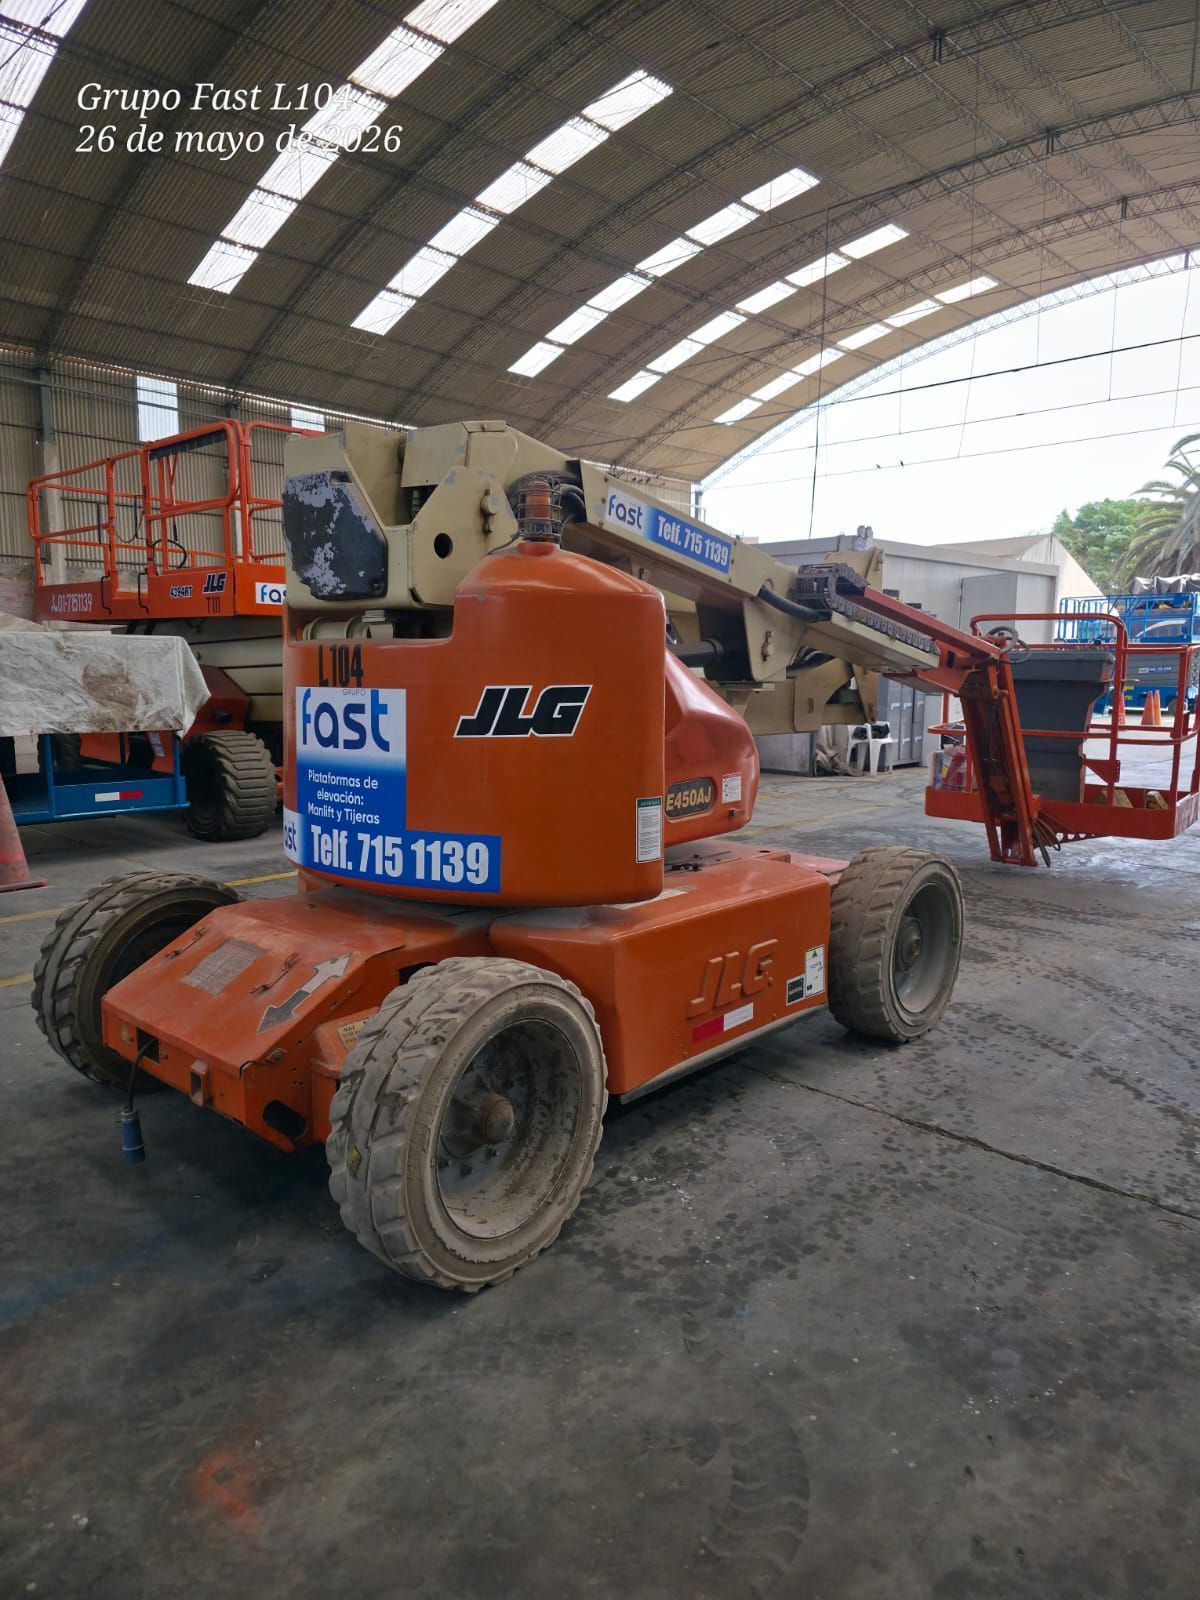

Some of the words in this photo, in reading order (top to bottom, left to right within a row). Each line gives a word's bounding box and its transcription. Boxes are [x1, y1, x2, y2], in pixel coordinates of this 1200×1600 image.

[608, 494, 643, 530] fast
[657, 515, 682, 546] Telf.
[684, 528, 703, 555] 715
[704, 539, 729, 566] 1139
[202, 572, 227, 594] JLG
[318, 644, 364, 688] L104
[342, 688, 367, 697] GRUPO
[302, 687, 390, 753] fast
[453, 685, 593, 738] JLG
[307, 768, 361, 788] Plataformas
[363, 775, 379, 790] de
[316, 786, 364, 806] elevación:
[307, 801, 335, 819] Manlift
[336, 809, 343, 823] y
[343, 808, 380, 825] Tijeras
[665, 785, 713, 812] E450AJ
[310, 825, 353, 870] Telf.
[358, 834, 404, 879] 715
[410, 838, 490, 885] 1139
[686, 938, 778, 1020] JLG
